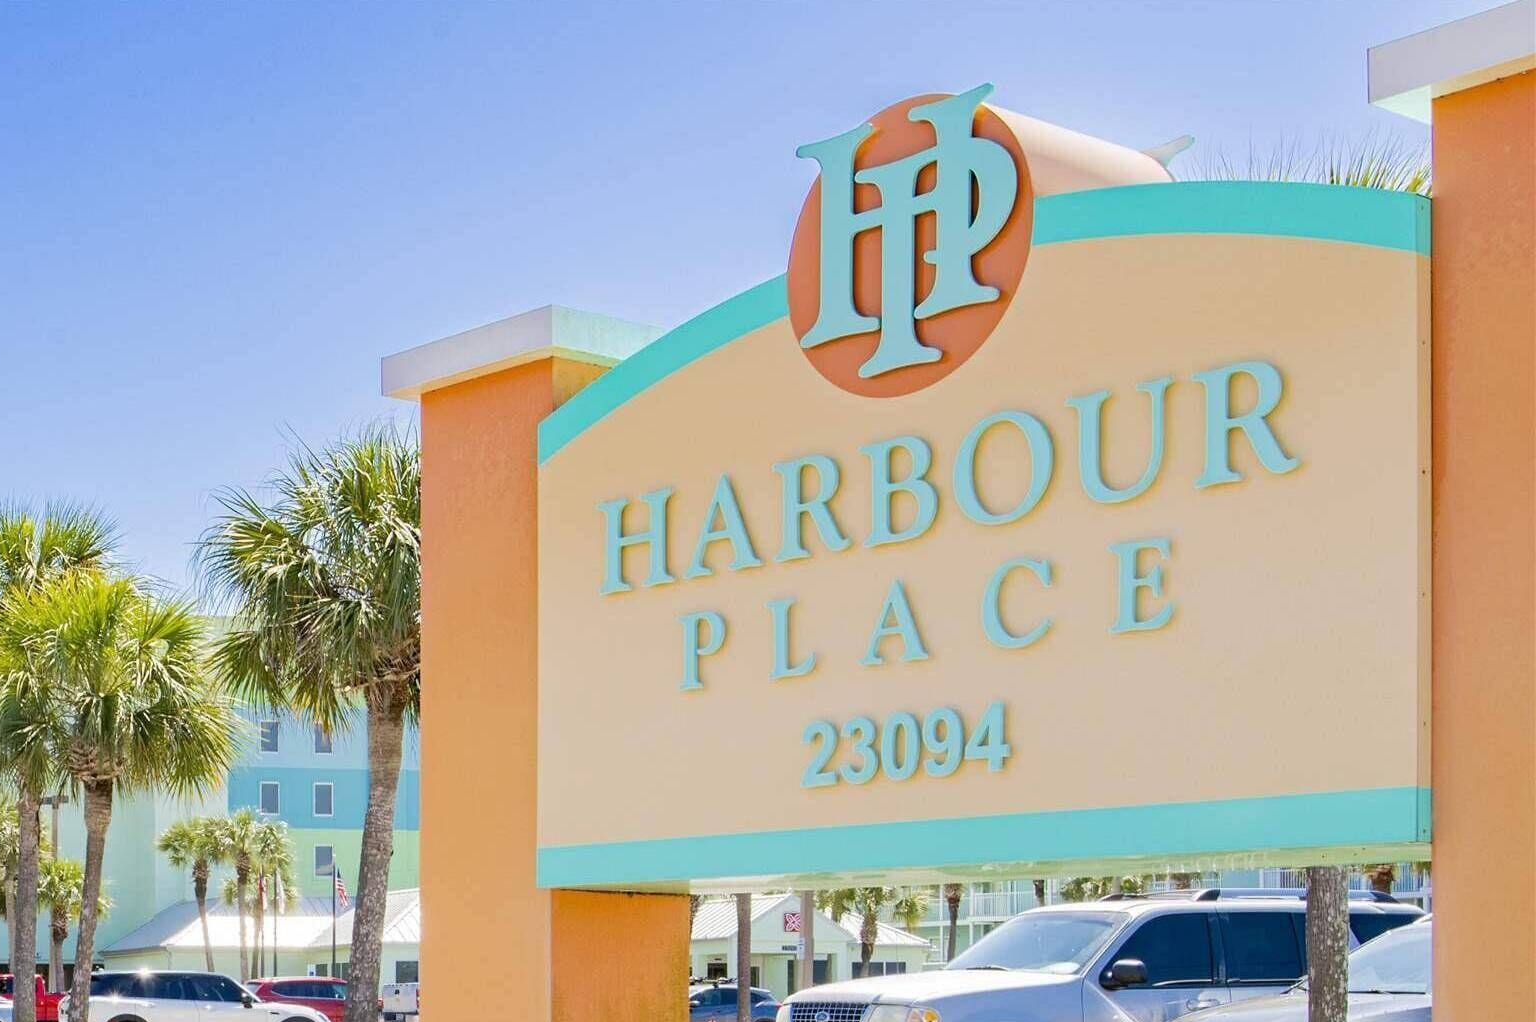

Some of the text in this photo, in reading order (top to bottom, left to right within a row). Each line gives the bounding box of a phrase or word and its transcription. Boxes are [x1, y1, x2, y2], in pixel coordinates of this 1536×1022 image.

[597, 359, 1302, 598] HARBOUR
[678, 538, 1179, 692] PLACE
[800, 701, 1012, 788] 23094
